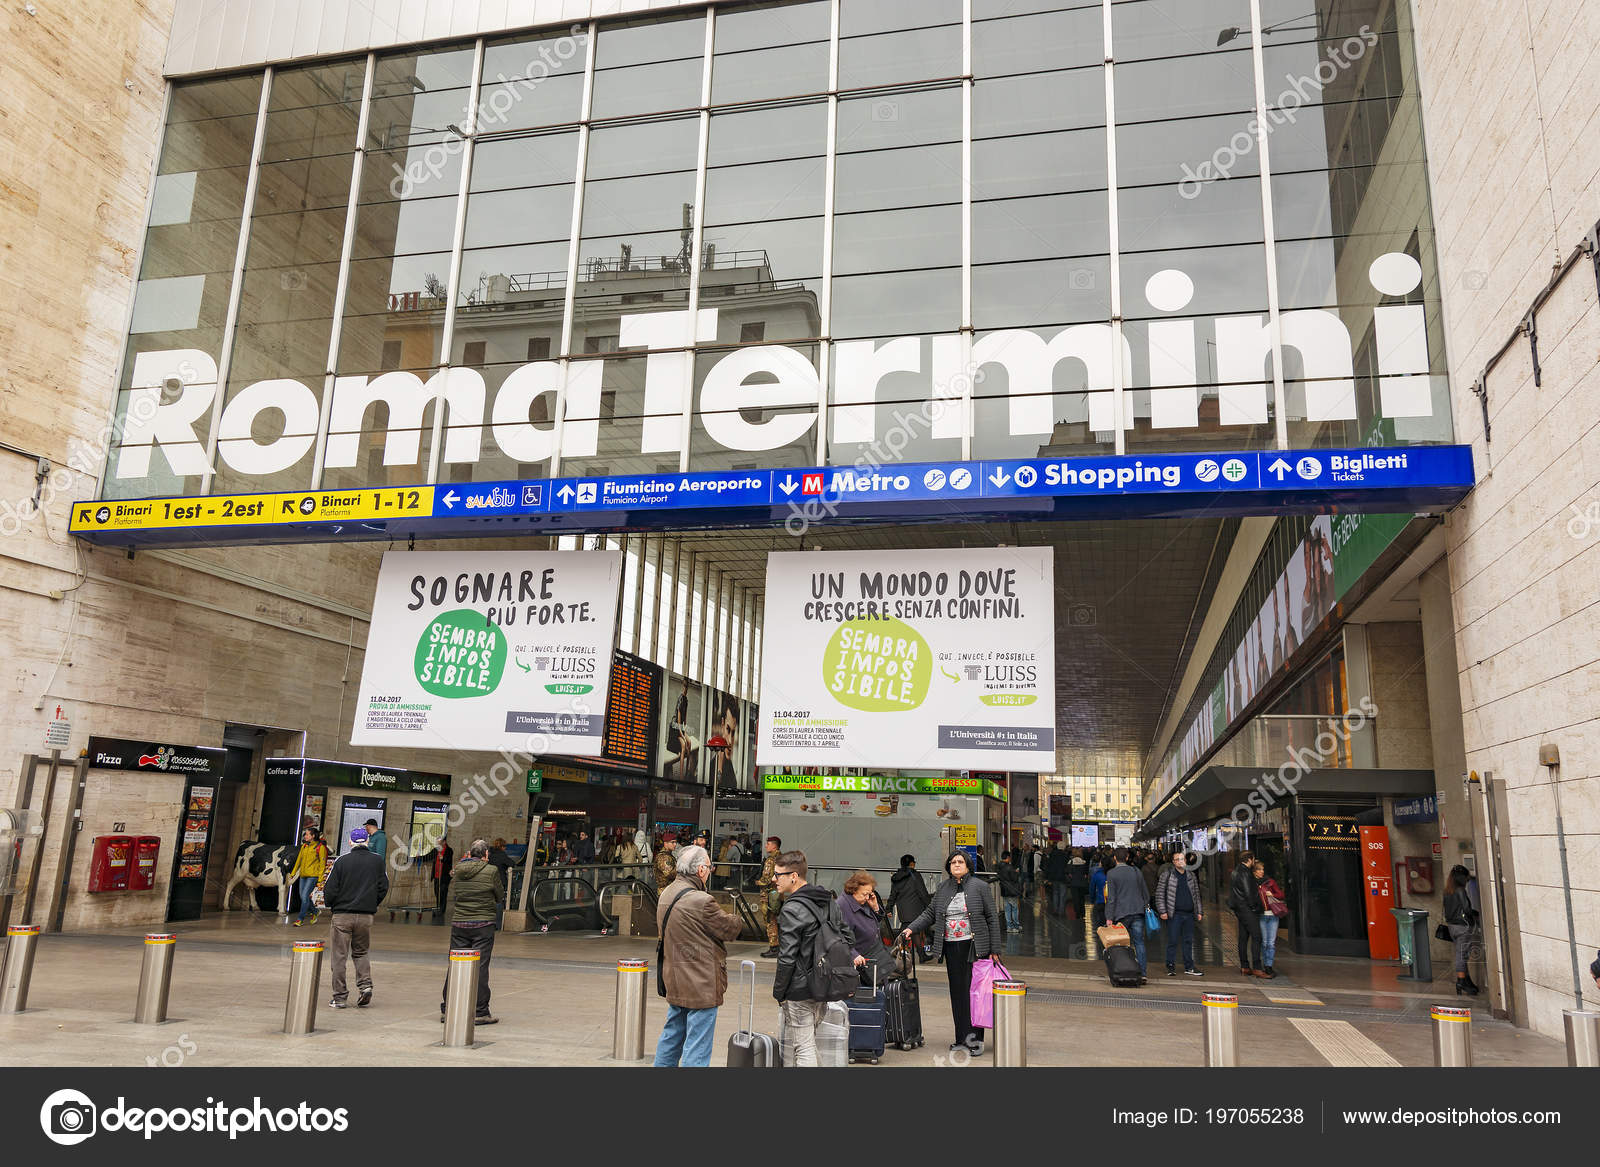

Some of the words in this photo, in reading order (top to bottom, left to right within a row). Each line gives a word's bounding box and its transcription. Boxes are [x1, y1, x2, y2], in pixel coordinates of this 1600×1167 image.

[1331, 454, 1408, 473] Biglietti
[803, 476, 822, 492] M
[830, 472, 910, 492] Metro
[1044, 461, 1181, 489] Shopping
[1331, 471, 1365, 482] Tickets
[603, 480, 675, 495] Fiumicino
[679, 477, 762, 494] Aeroporto
[321, 493, 361, 507] Binari
[373, 491, 420, 510] 1-12
[602, 495, 638, 505] Fiumicino
[640, 494, 668, 505] Airport
[116, 503, 152, 517] Binari
[163, 503, 202, 520] 1est
[221, 500, 264, 517] 2est
[320, 508, 351, 517] Platforms
[113, 517, 142, 526] Platforms
[811, 572, 844, 599] UN
[860, 571, 948, 599] MONDO
[959, 567, 1016, 599] DOVE
[526, 601, 596, 625] FORTE.
[804, 600, 890, 622] CRESCERE
[895, 599, 942, 619] SENZA
[948, 598, 1025, 620] CONFINI.
[430, 623, 496, 650] SEMBRA
[840, 627, 918, 661] SEMBRA
[425, 644, 492, 670] IMPOS
[551, 657, 596, 673] LUISS
[835, 650, 914, 682] IMPOS
[984, 665, 1037, 681] LUISS
[563, 717, 571, 725] in
[773, 719, 796, 727] PROVA
[797, 719, 804, 727] DI
[805, 719, 848, 727] AMMISSIONE
[1007, 731, 1015, 740] in
[1017, 732, 1038, 740] Italia
[96, 752, 122, 765] Pizza
[360, 767, 396, 786] Roadhouse
[766, 774, 816, 784] SANDWICH
[823, 776, 856, 790] BAR
[861, 776, 917, 792] SNACK
[932, 779, 977, 787] ESPRESSO
[412, 782, 426, 791] Steak
[431, 783, 442, 792] Grill
[1368, 842, 1384, 850] SOS
